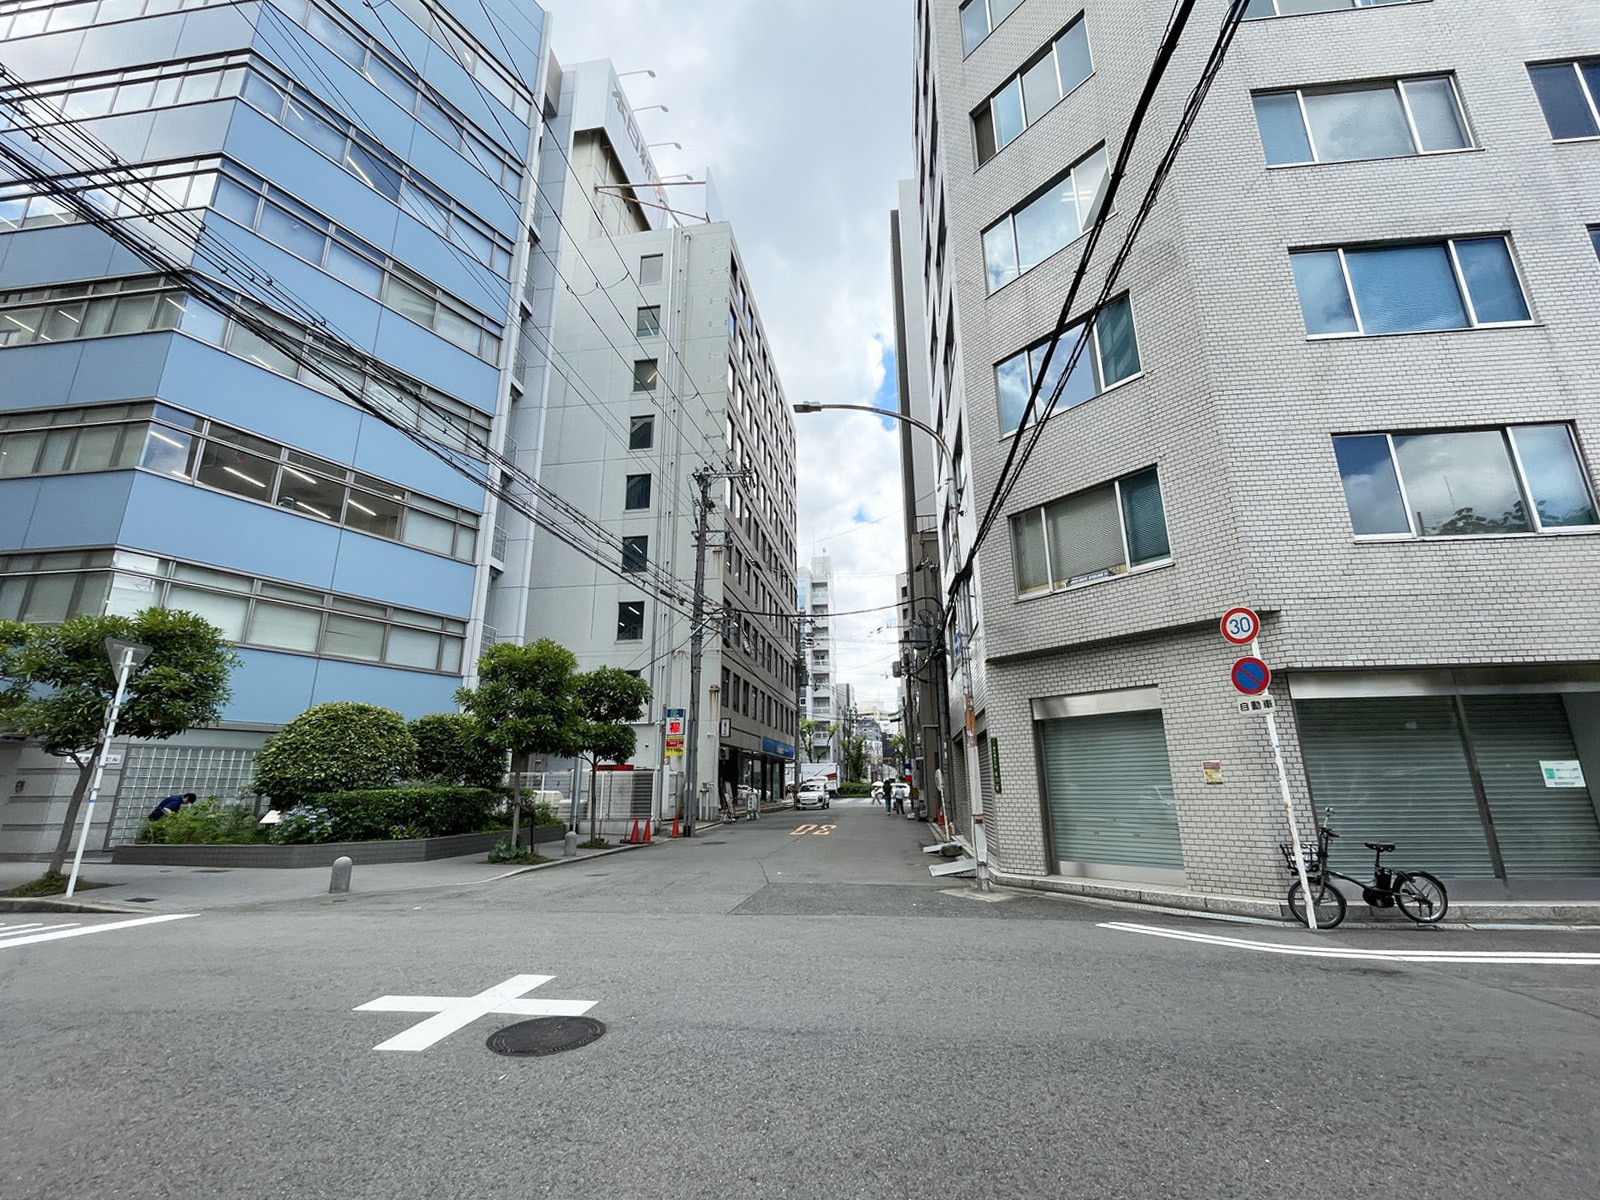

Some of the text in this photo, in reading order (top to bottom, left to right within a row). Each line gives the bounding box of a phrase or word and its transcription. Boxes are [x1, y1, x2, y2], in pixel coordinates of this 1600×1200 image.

[1229, 616, 1251, 635] 30
[1239, 699, 1273, 711] 自動車
